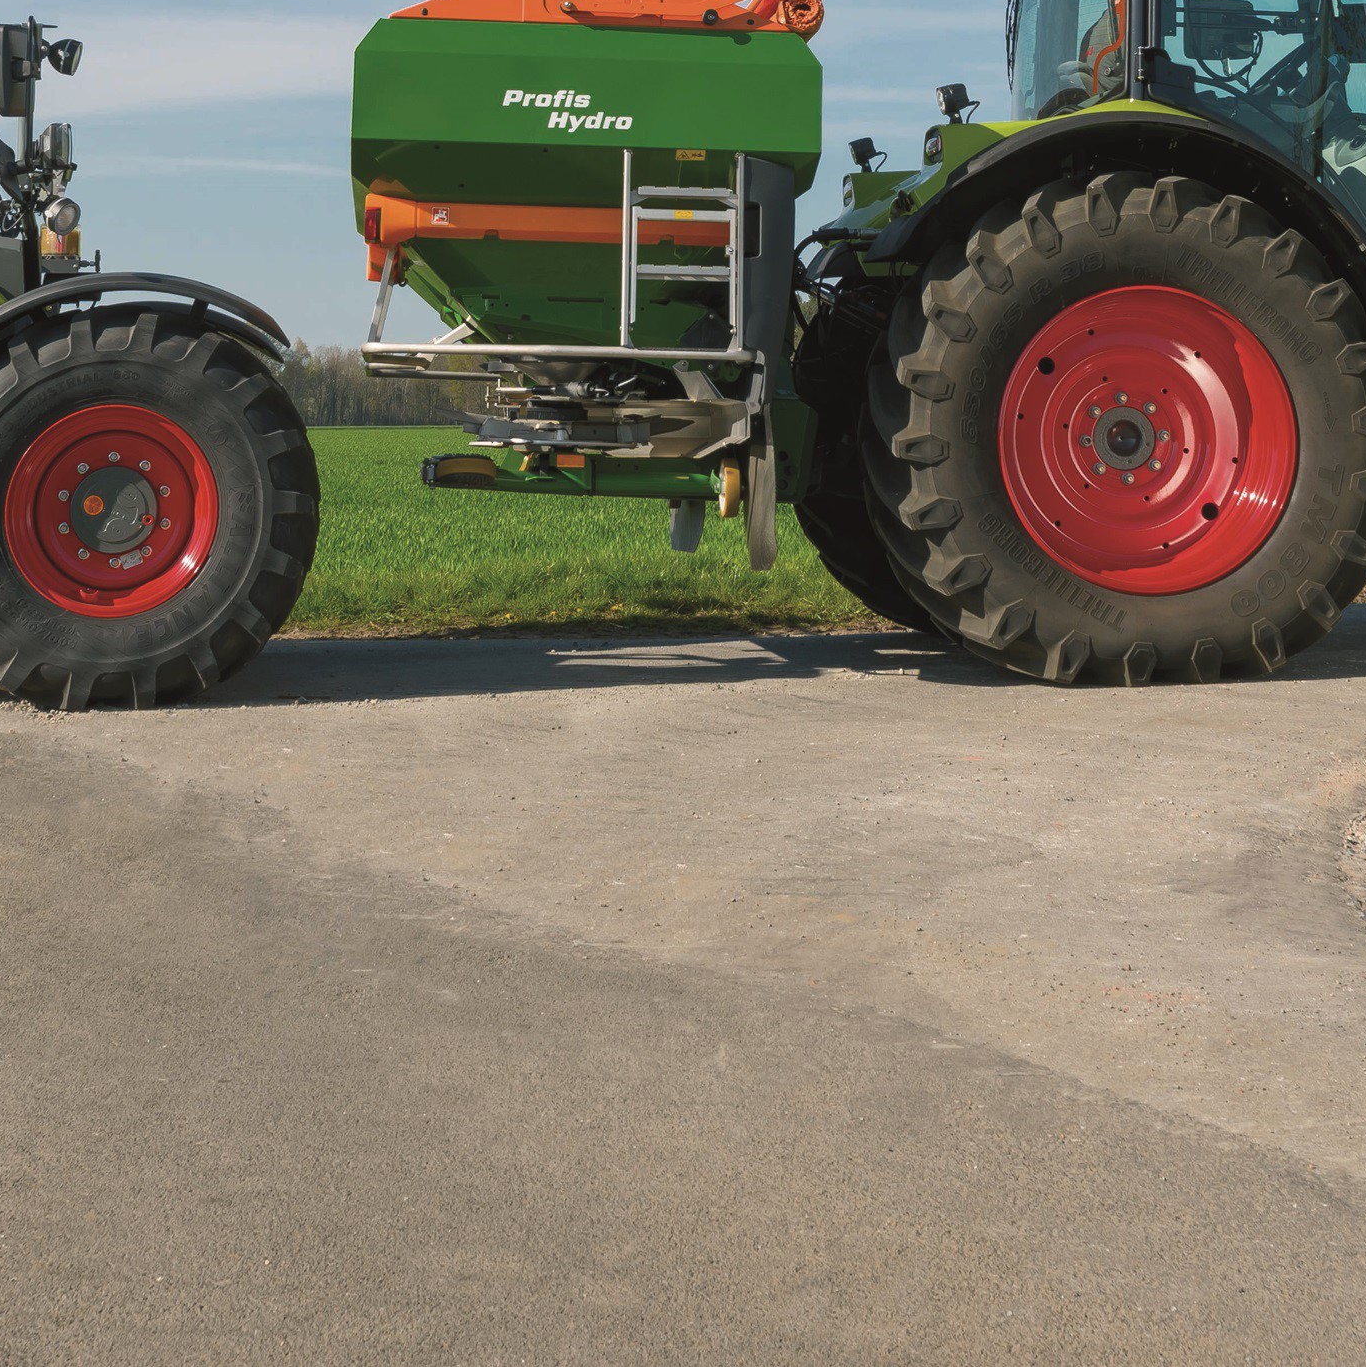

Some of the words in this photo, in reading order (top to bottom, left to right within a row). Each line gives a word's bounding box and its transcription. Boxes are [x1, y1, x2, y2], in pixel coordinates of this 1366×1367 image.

[502, 89, 591, 108] Profis
[547, 111, 633, 133] Hydro
[1177, 242, 1325, 366] TRELLEBORG
[974, 511, 1126, 633] TRELLEBORG
